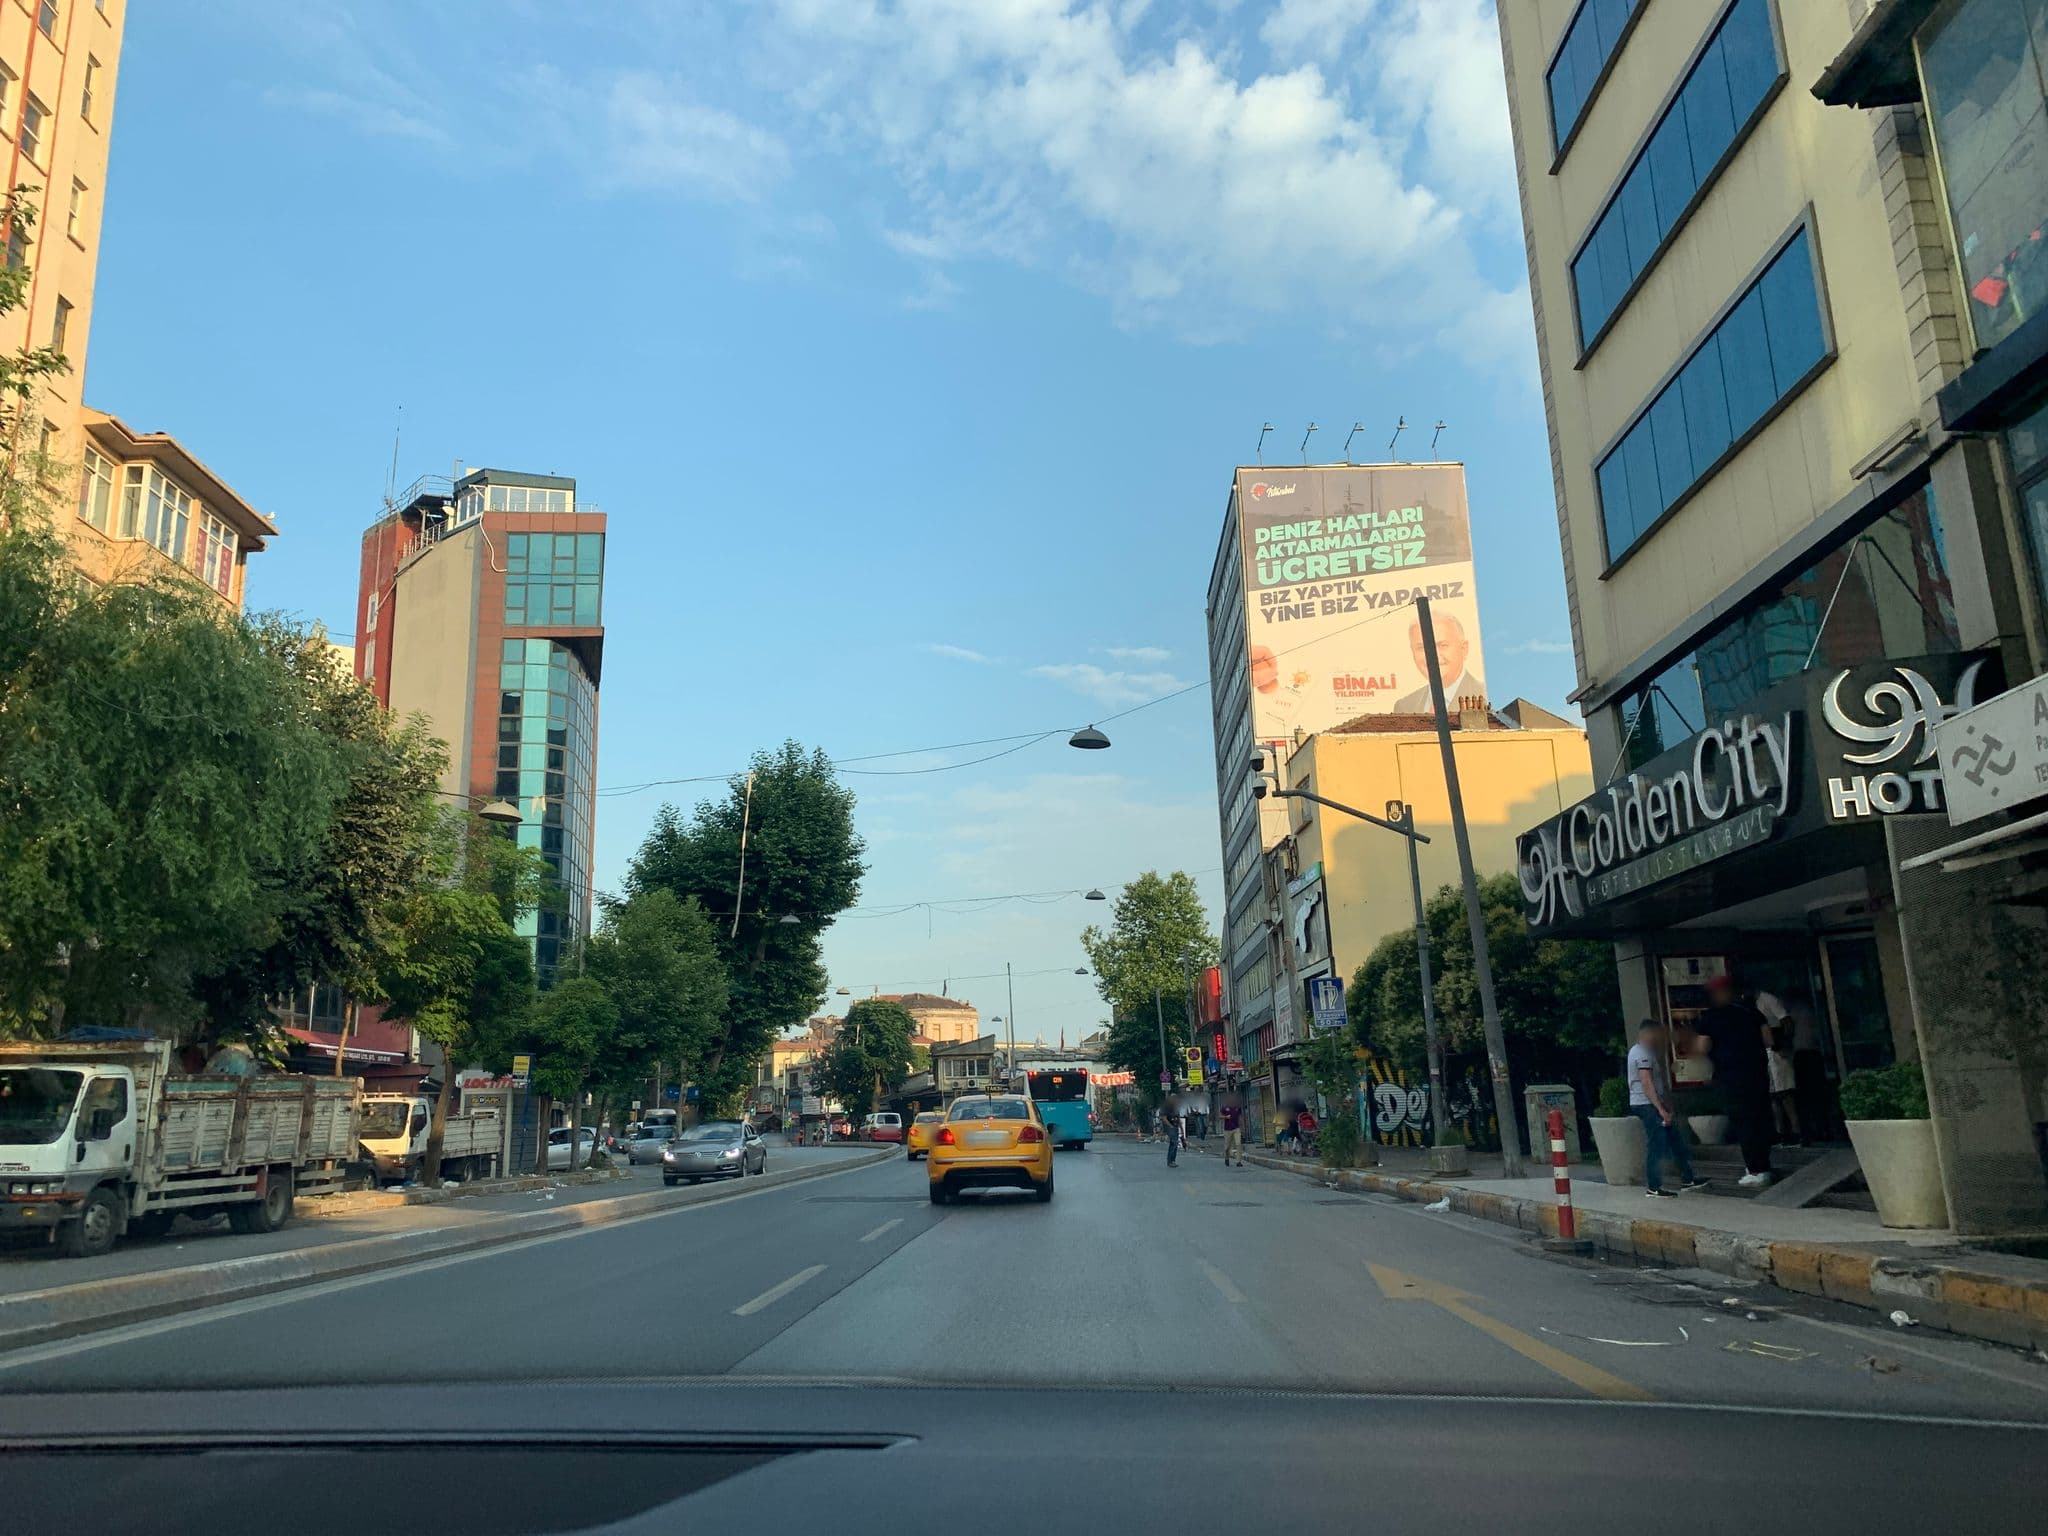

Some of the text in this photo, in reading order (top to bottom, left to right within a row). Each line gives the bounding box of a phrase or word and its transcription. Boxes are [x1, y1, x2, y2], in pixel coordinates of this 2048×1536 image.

[1254, 505, 1424, 545] DENİZ HATLARI
[1254, 523, 1427, 562] AKTARMALARDA
[1257, 540, 1427, 586] ÜCRETSİZ
[1260, 579, 1366, 606] BİZ YAPTIK
[1260, 581, 1465, 624] YİNE BİZ YAPARIZ
[1332, 673, 1397, 690] BİNALİ
[1334, 690, 1375, 698] YILDIRIM
